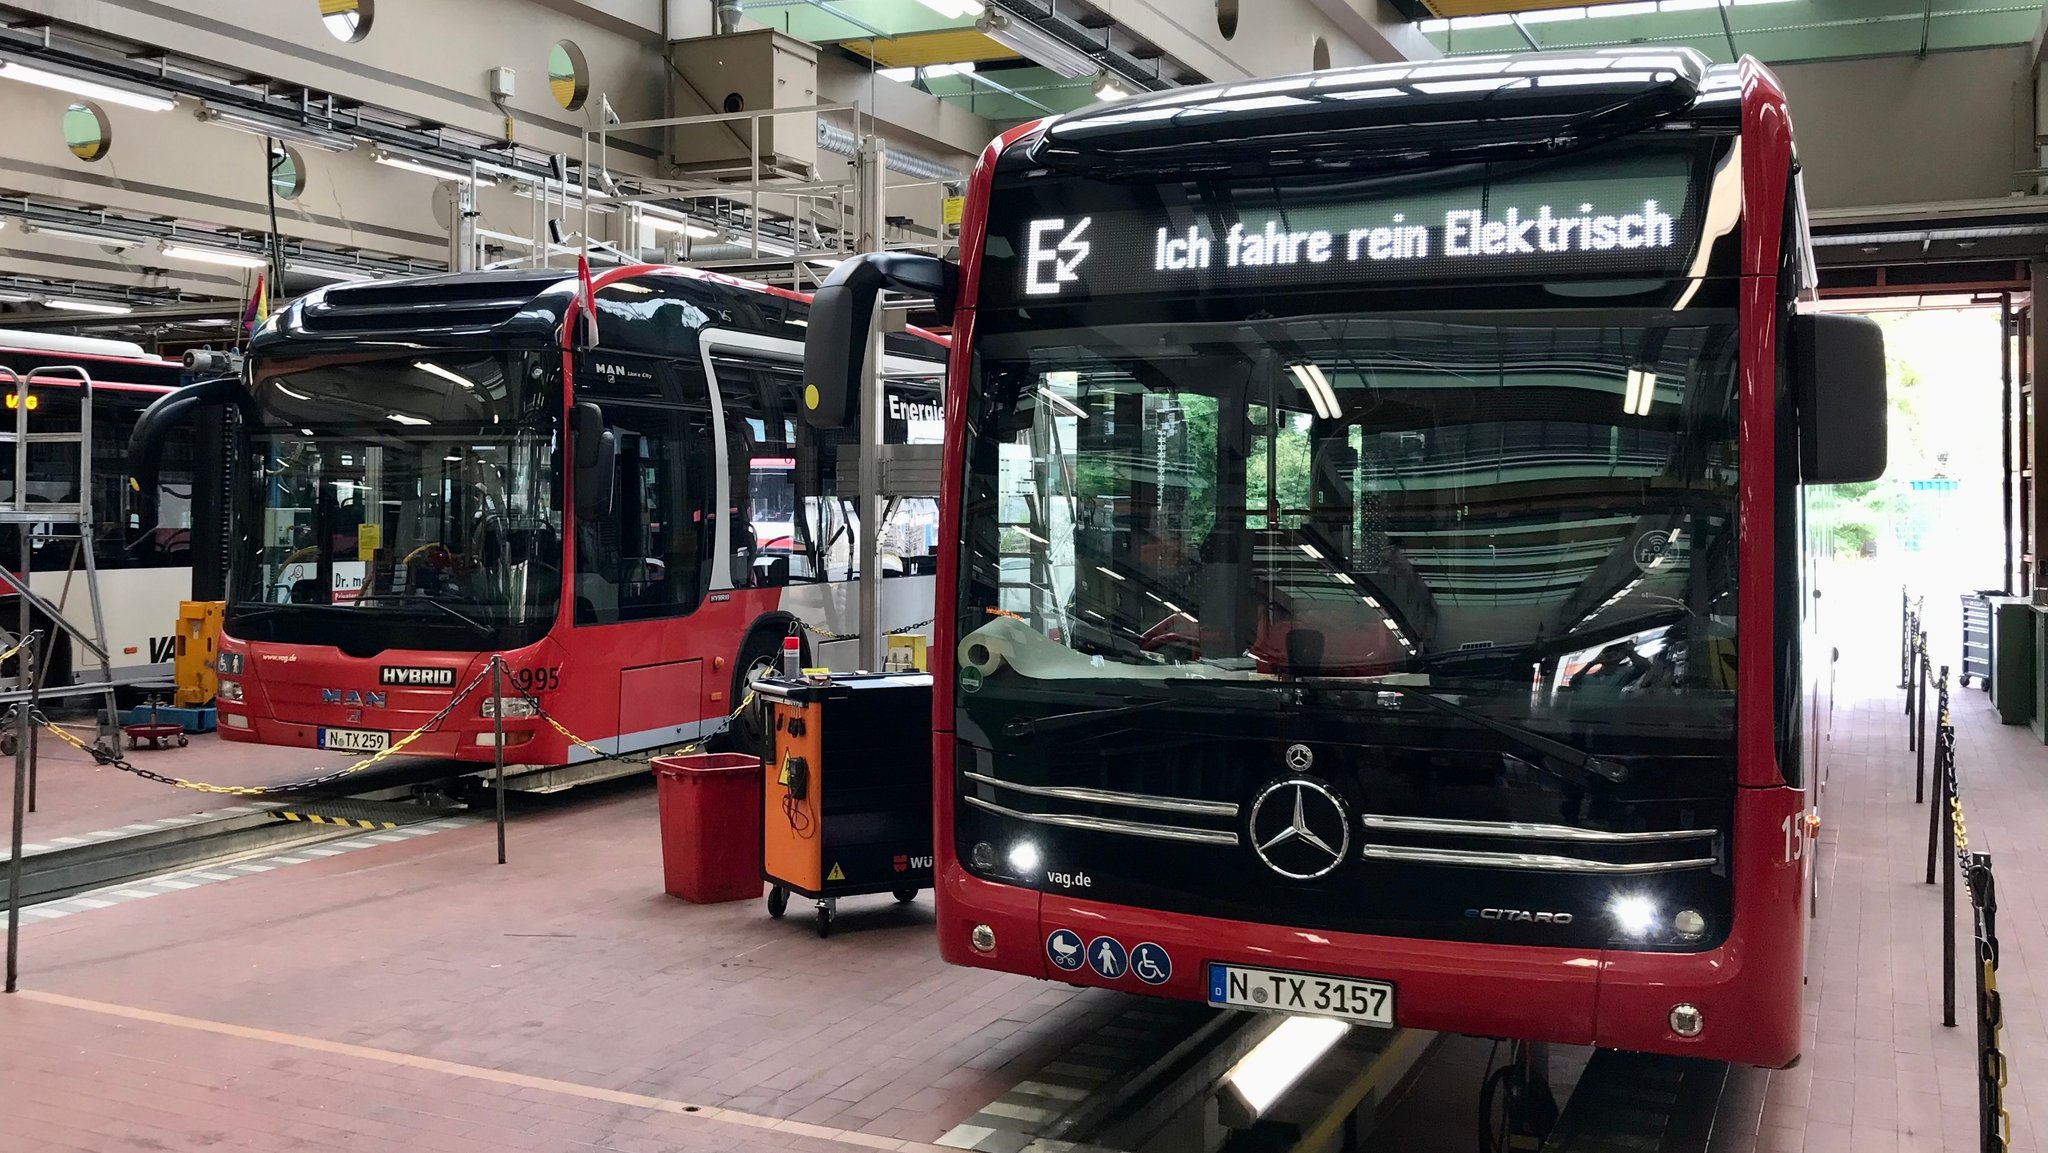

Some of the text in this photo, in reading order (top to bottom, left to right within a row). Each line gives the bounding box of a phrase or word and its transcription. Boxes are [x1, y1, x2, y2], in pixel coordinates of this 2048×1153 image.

[1156, 199, 1675, 271] Ich fahre rein Elektrisch
[595, 363, 626, 376] MAN
[6, 394, 38, 410] VG
[335, 572, 349, 588] Dr.
[383, 668, 452, 685] HYBRID
[518, 666, 560, 691] 995
[321, 688, 388, 708] MAN
[330, 731, 339, 746] N
[345, 734, 360, 748] TX
[362, 735, 384, 749] 259
[1047, 871, 1092, 888] vag.de
[1464, 907, 1573, 924] eCITARO
[1215, 971, 1387, 1017] D N TX 3157
